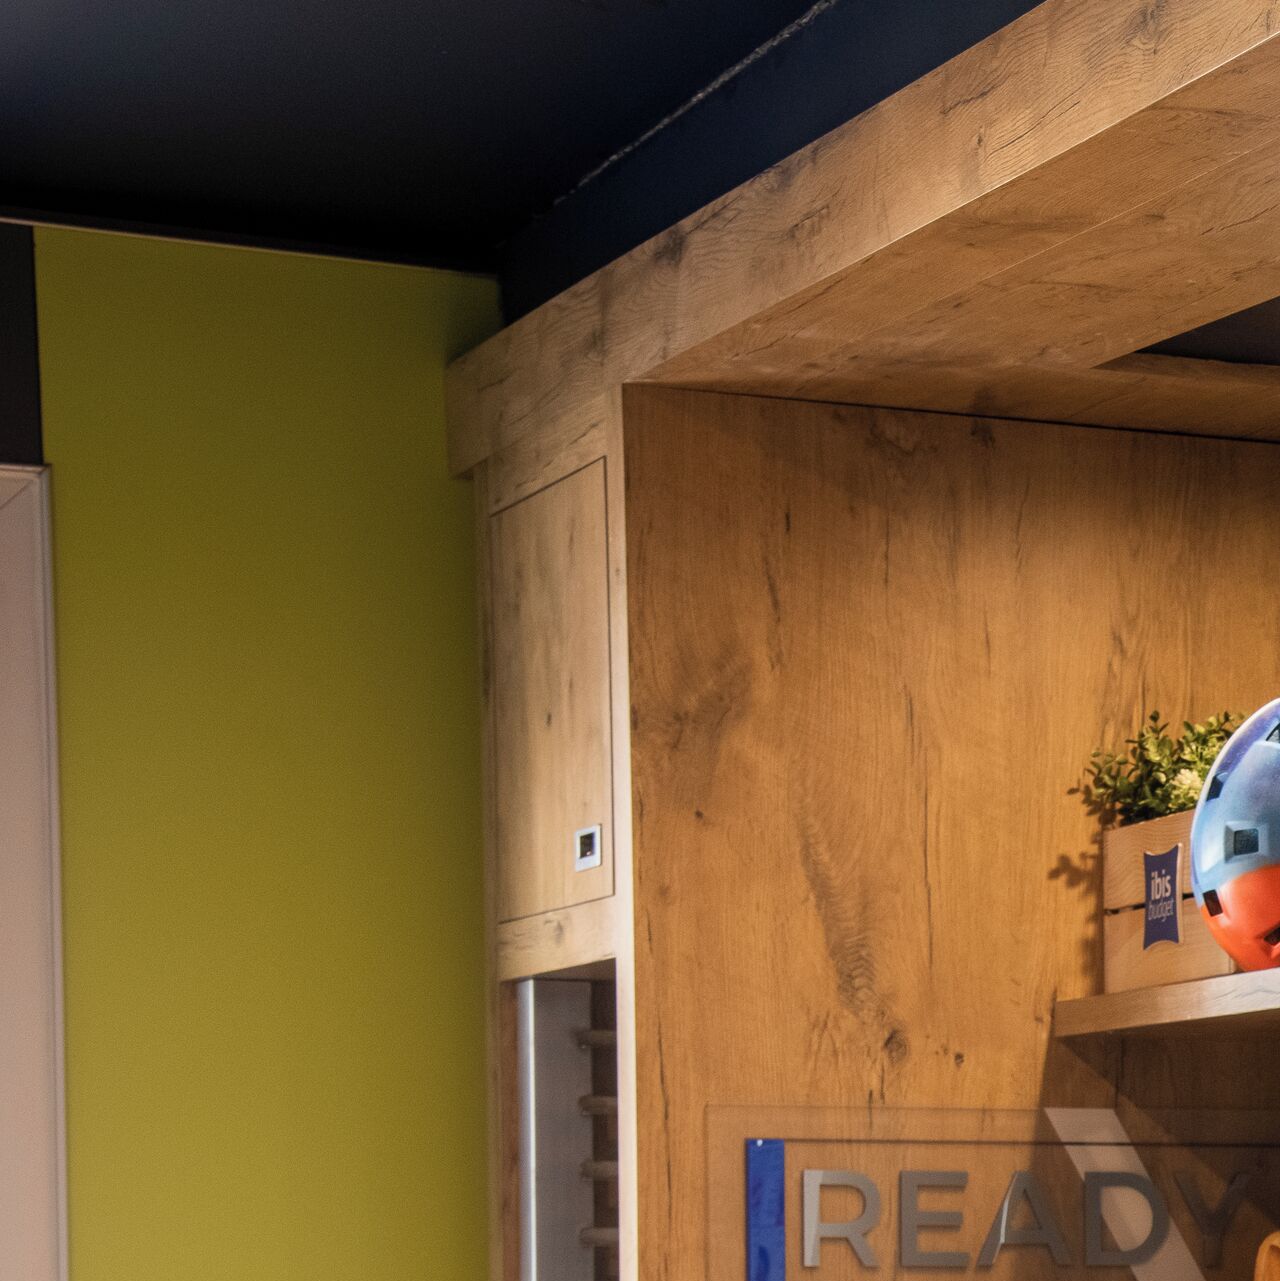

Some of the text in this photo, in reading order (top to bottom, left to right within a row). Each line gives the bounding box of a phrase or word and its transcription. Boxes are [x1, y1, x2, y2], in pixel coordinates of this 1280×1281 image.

[1151, 869, 1171, 901] ibis
[1148, 897, 1174, 922] budget
[801, 1168, 1249, 1270] READY
